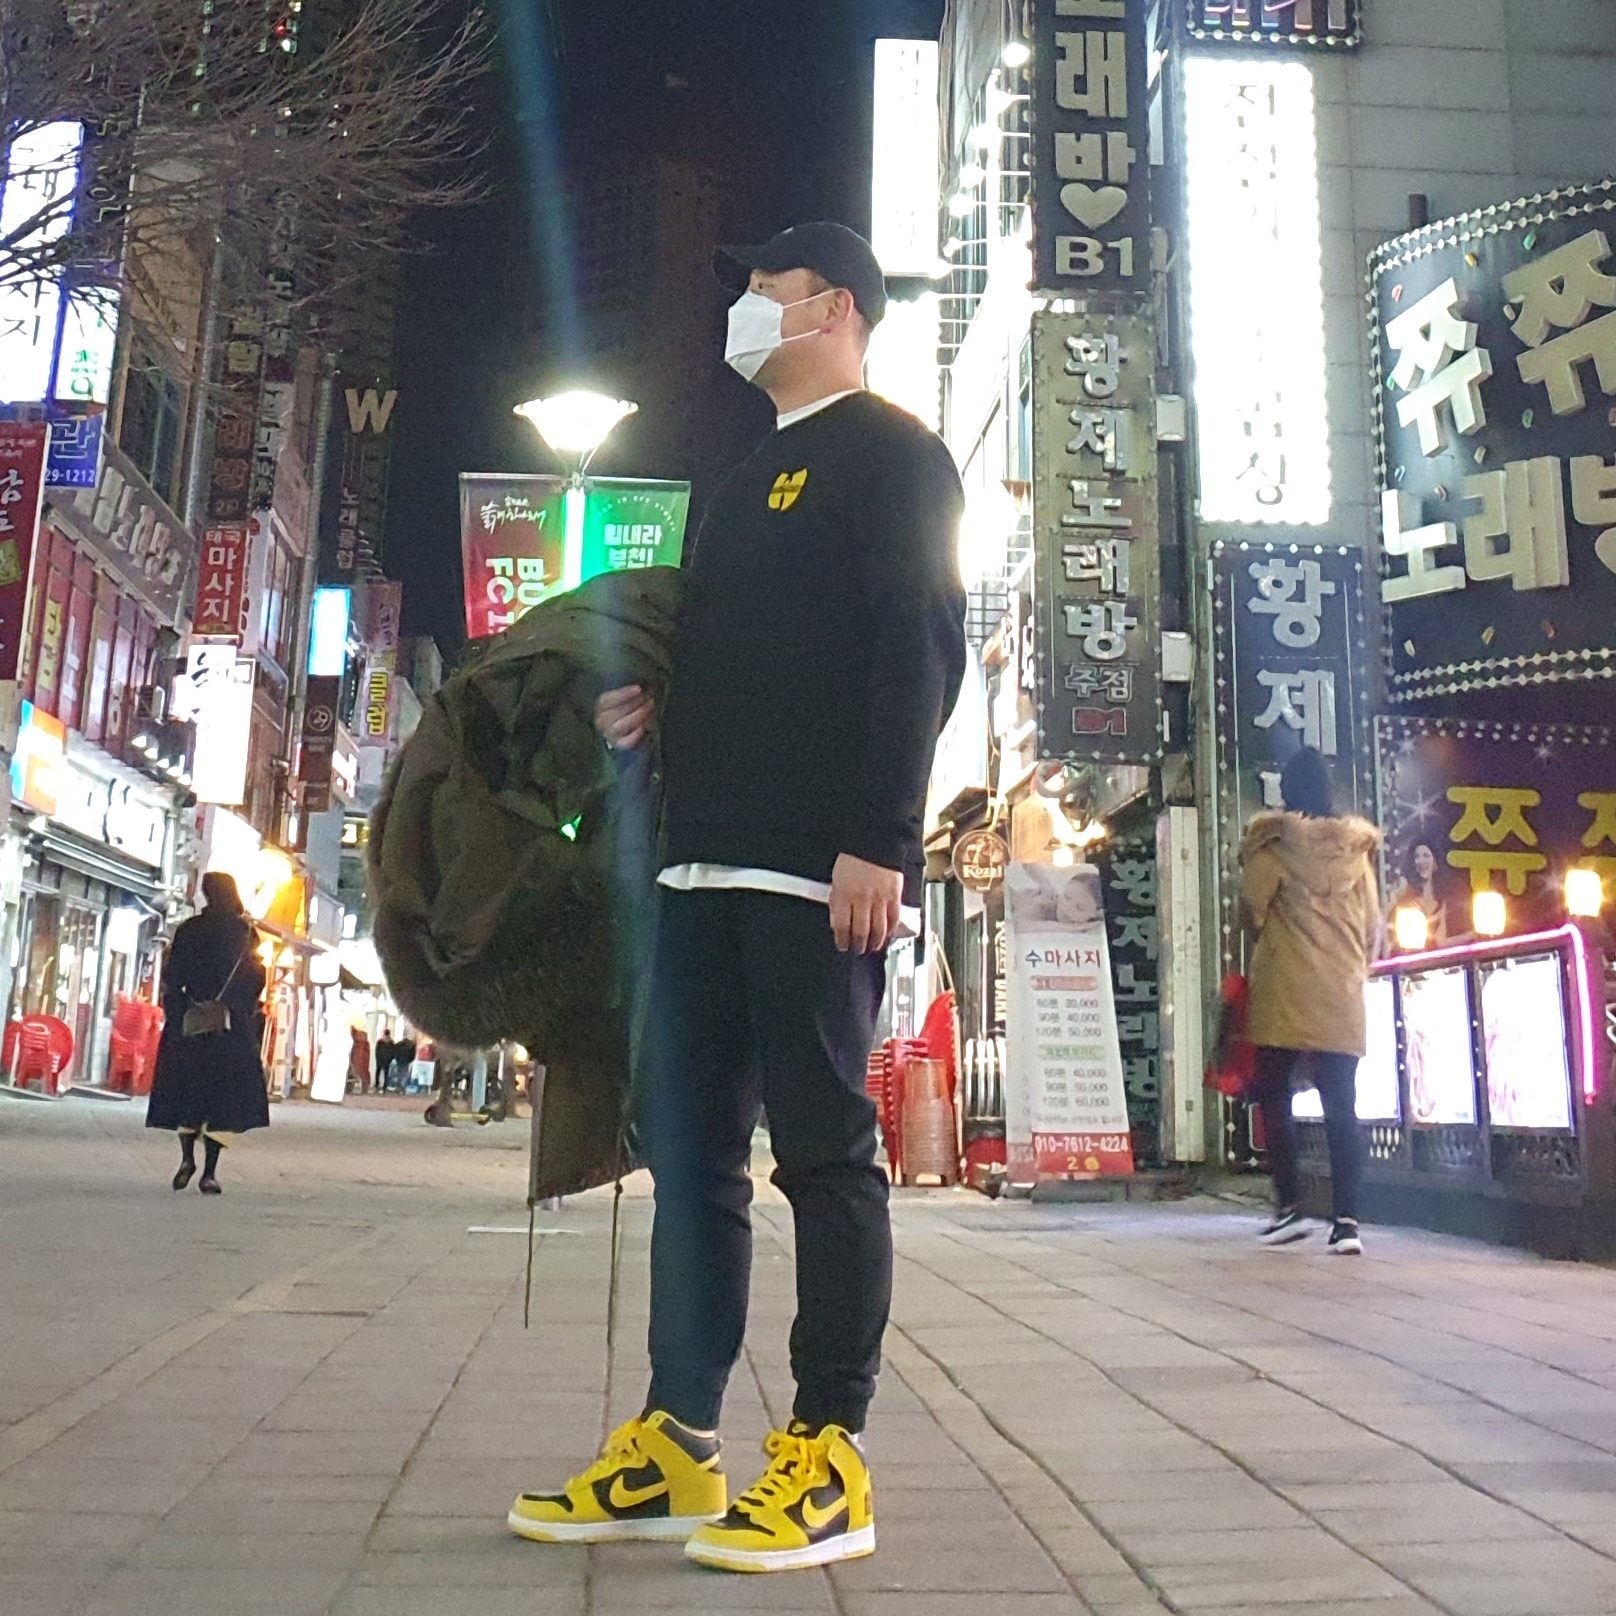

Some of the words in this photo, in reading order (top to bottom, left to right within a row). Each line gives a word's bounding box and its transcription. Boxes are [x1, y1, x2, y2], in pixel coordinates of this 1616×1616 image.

[1055, 236, 1133, 277] B1
[1061, 333, 1138, 660] 황제노래방
[203, 546, 236, 624] 마사지
[1064, 665, 1133, 702] 주점
[1025, 949, 1101, 969] 수마사지
